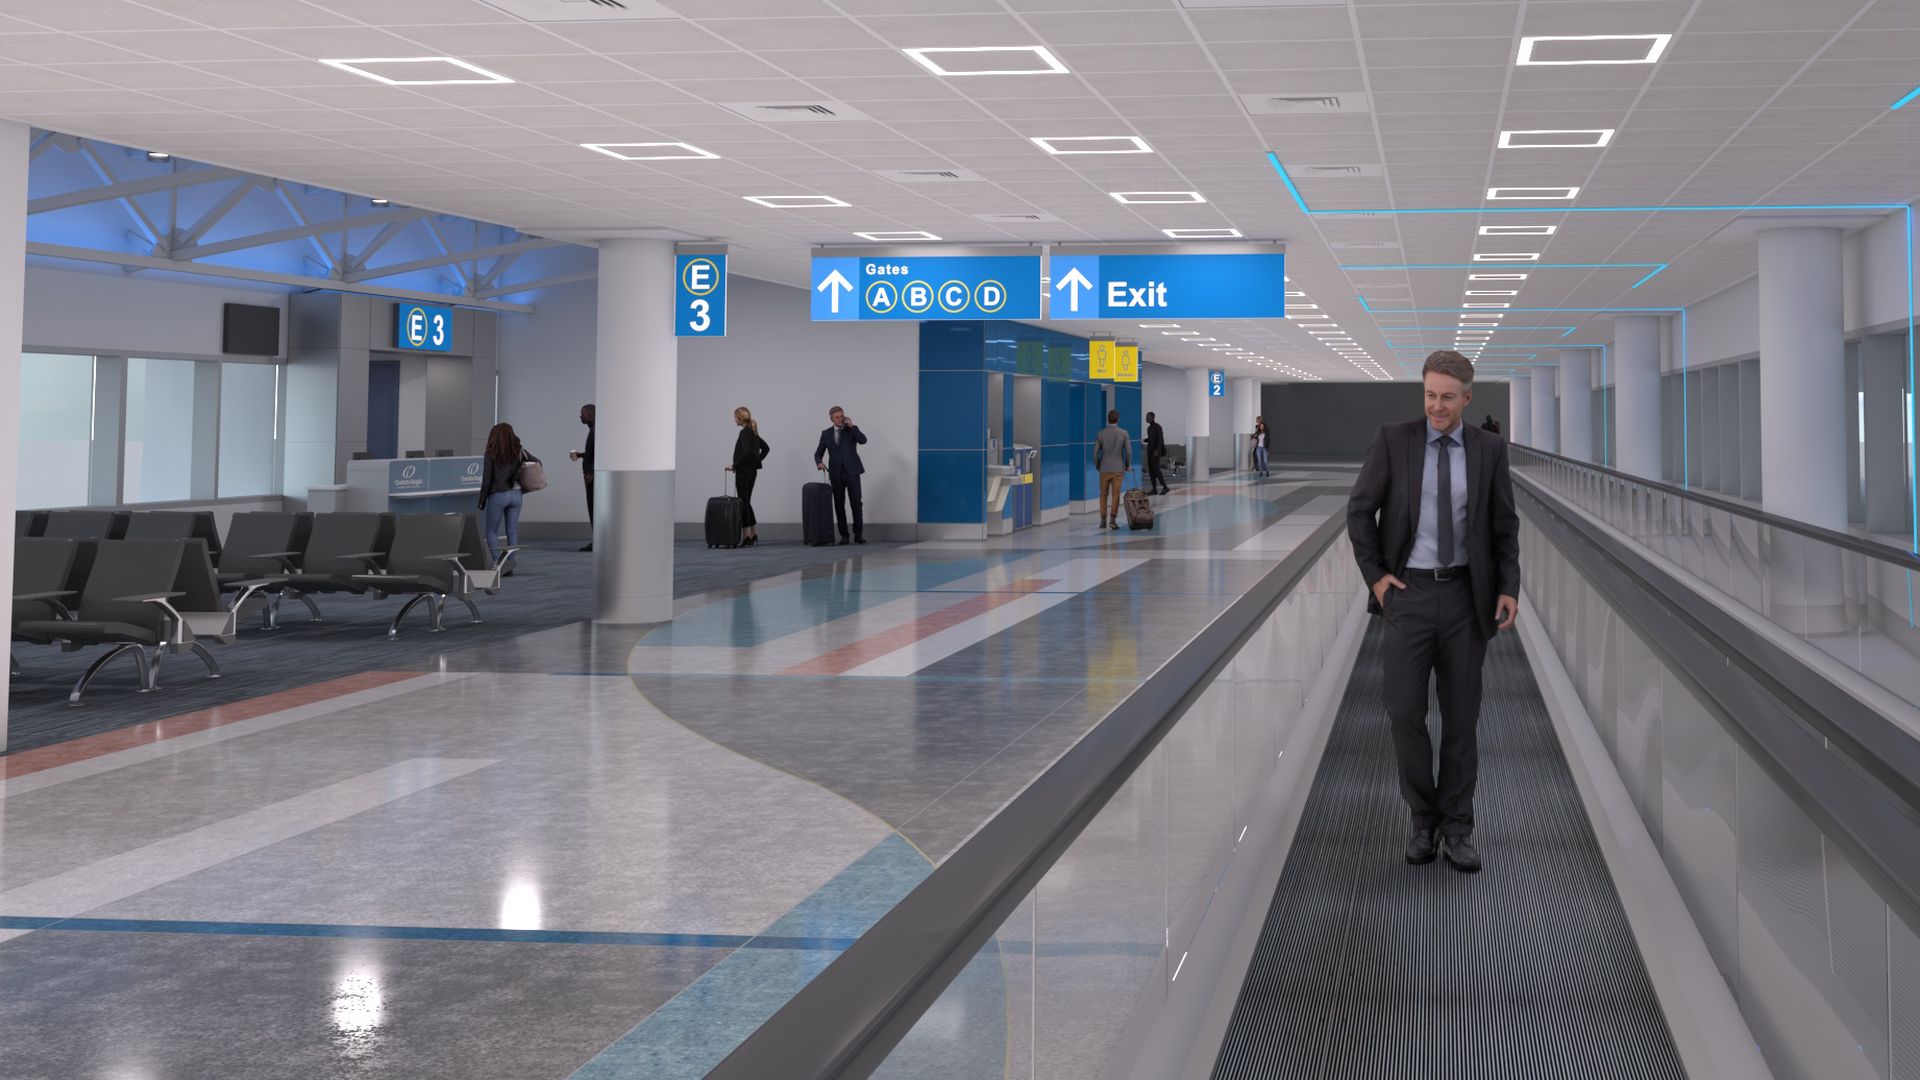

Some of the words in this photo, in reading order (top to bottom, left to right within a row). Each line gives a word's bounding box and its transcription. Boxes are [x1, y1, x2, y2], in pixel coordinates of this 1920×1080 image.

[691, 264, 710, 289] E
[865, 263, 909, 276] Gates
[872, 287, 891, 307] A
[910, 287, 928, 307] B
[945, 286, 962, 307] C
[983, 286, 1000, 306] D
[1107, 281, 1168, 307] Exit
[689, 298, 711, 332] 3
[411, 314, 423, 341] E
[432, 314, 445, 346] 3
[1213, 384, 1221, 396] 2
